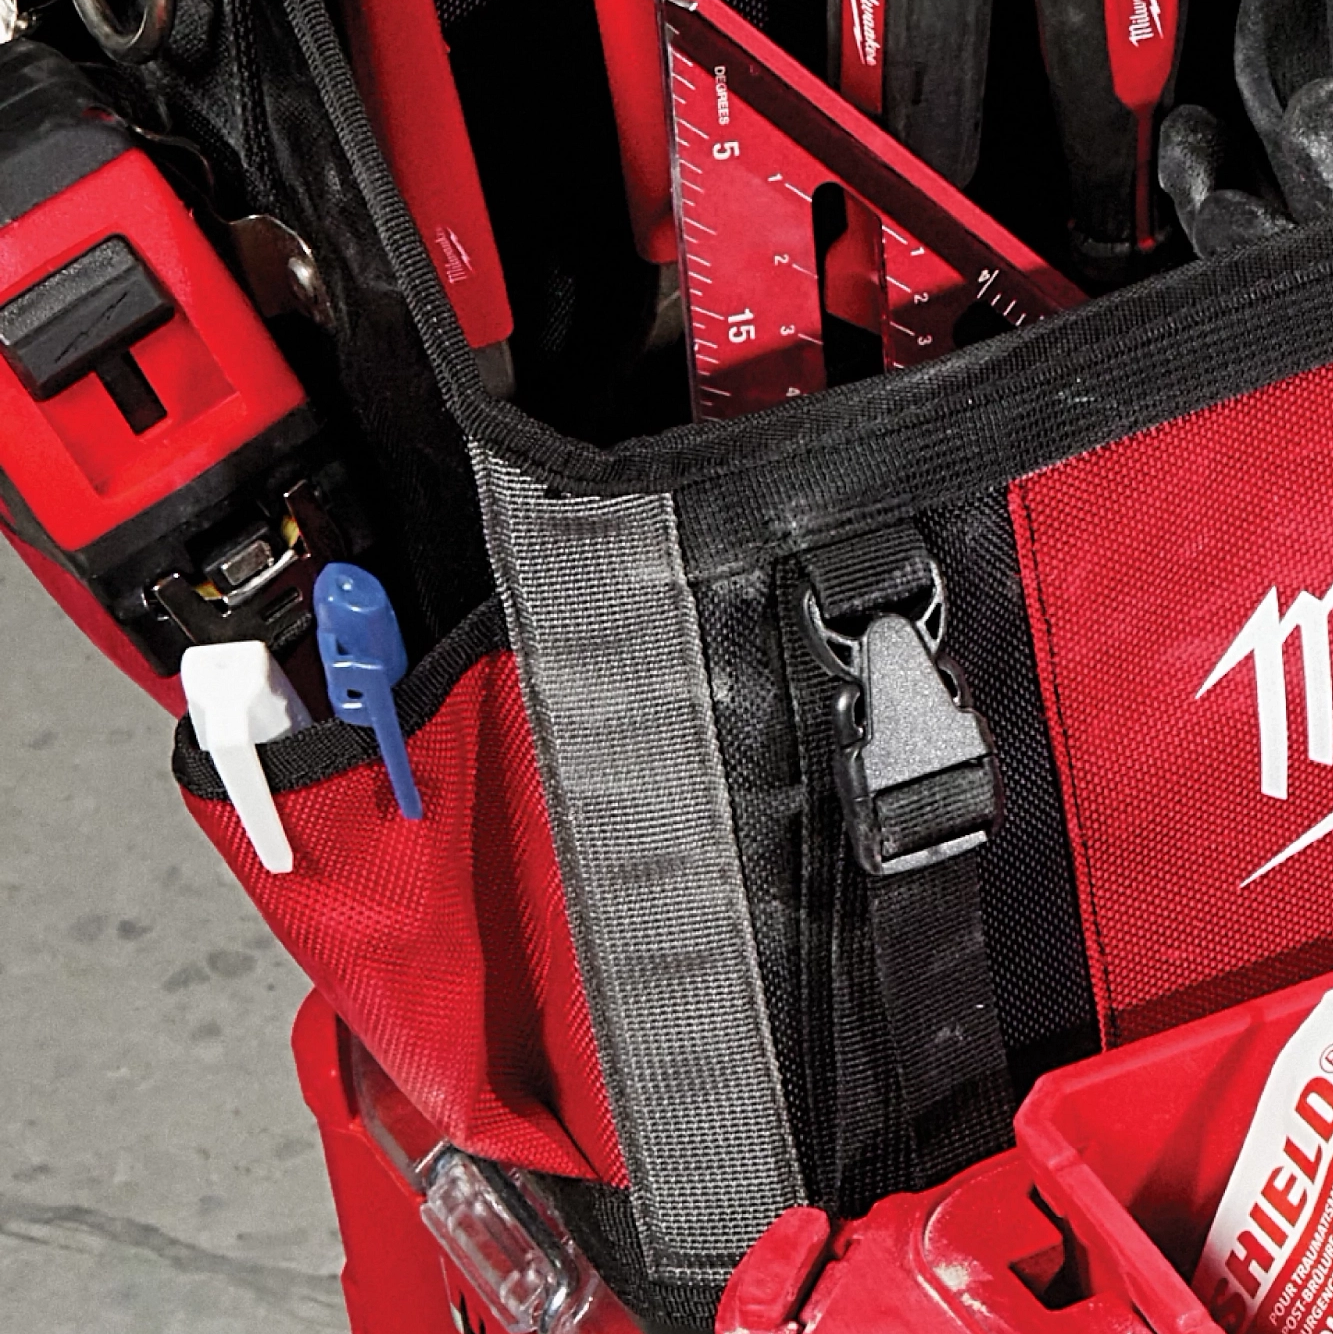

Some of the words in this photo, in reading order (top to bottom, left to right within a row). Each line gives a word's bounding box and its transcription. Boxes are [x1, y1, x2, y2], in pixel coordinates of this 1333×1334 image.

[714, 65, 730, 126] DEGREES
[712, 140, 740, 161] 5
[773, 253, 790, 266] 2
[913, 292, 930, 305] 2
[727, 308, 756, 344] 15
[779, 324, 796, 337] 3
[917, 334, 933, 346] 3
[1269, 1283, 1298, 1327] POUR
